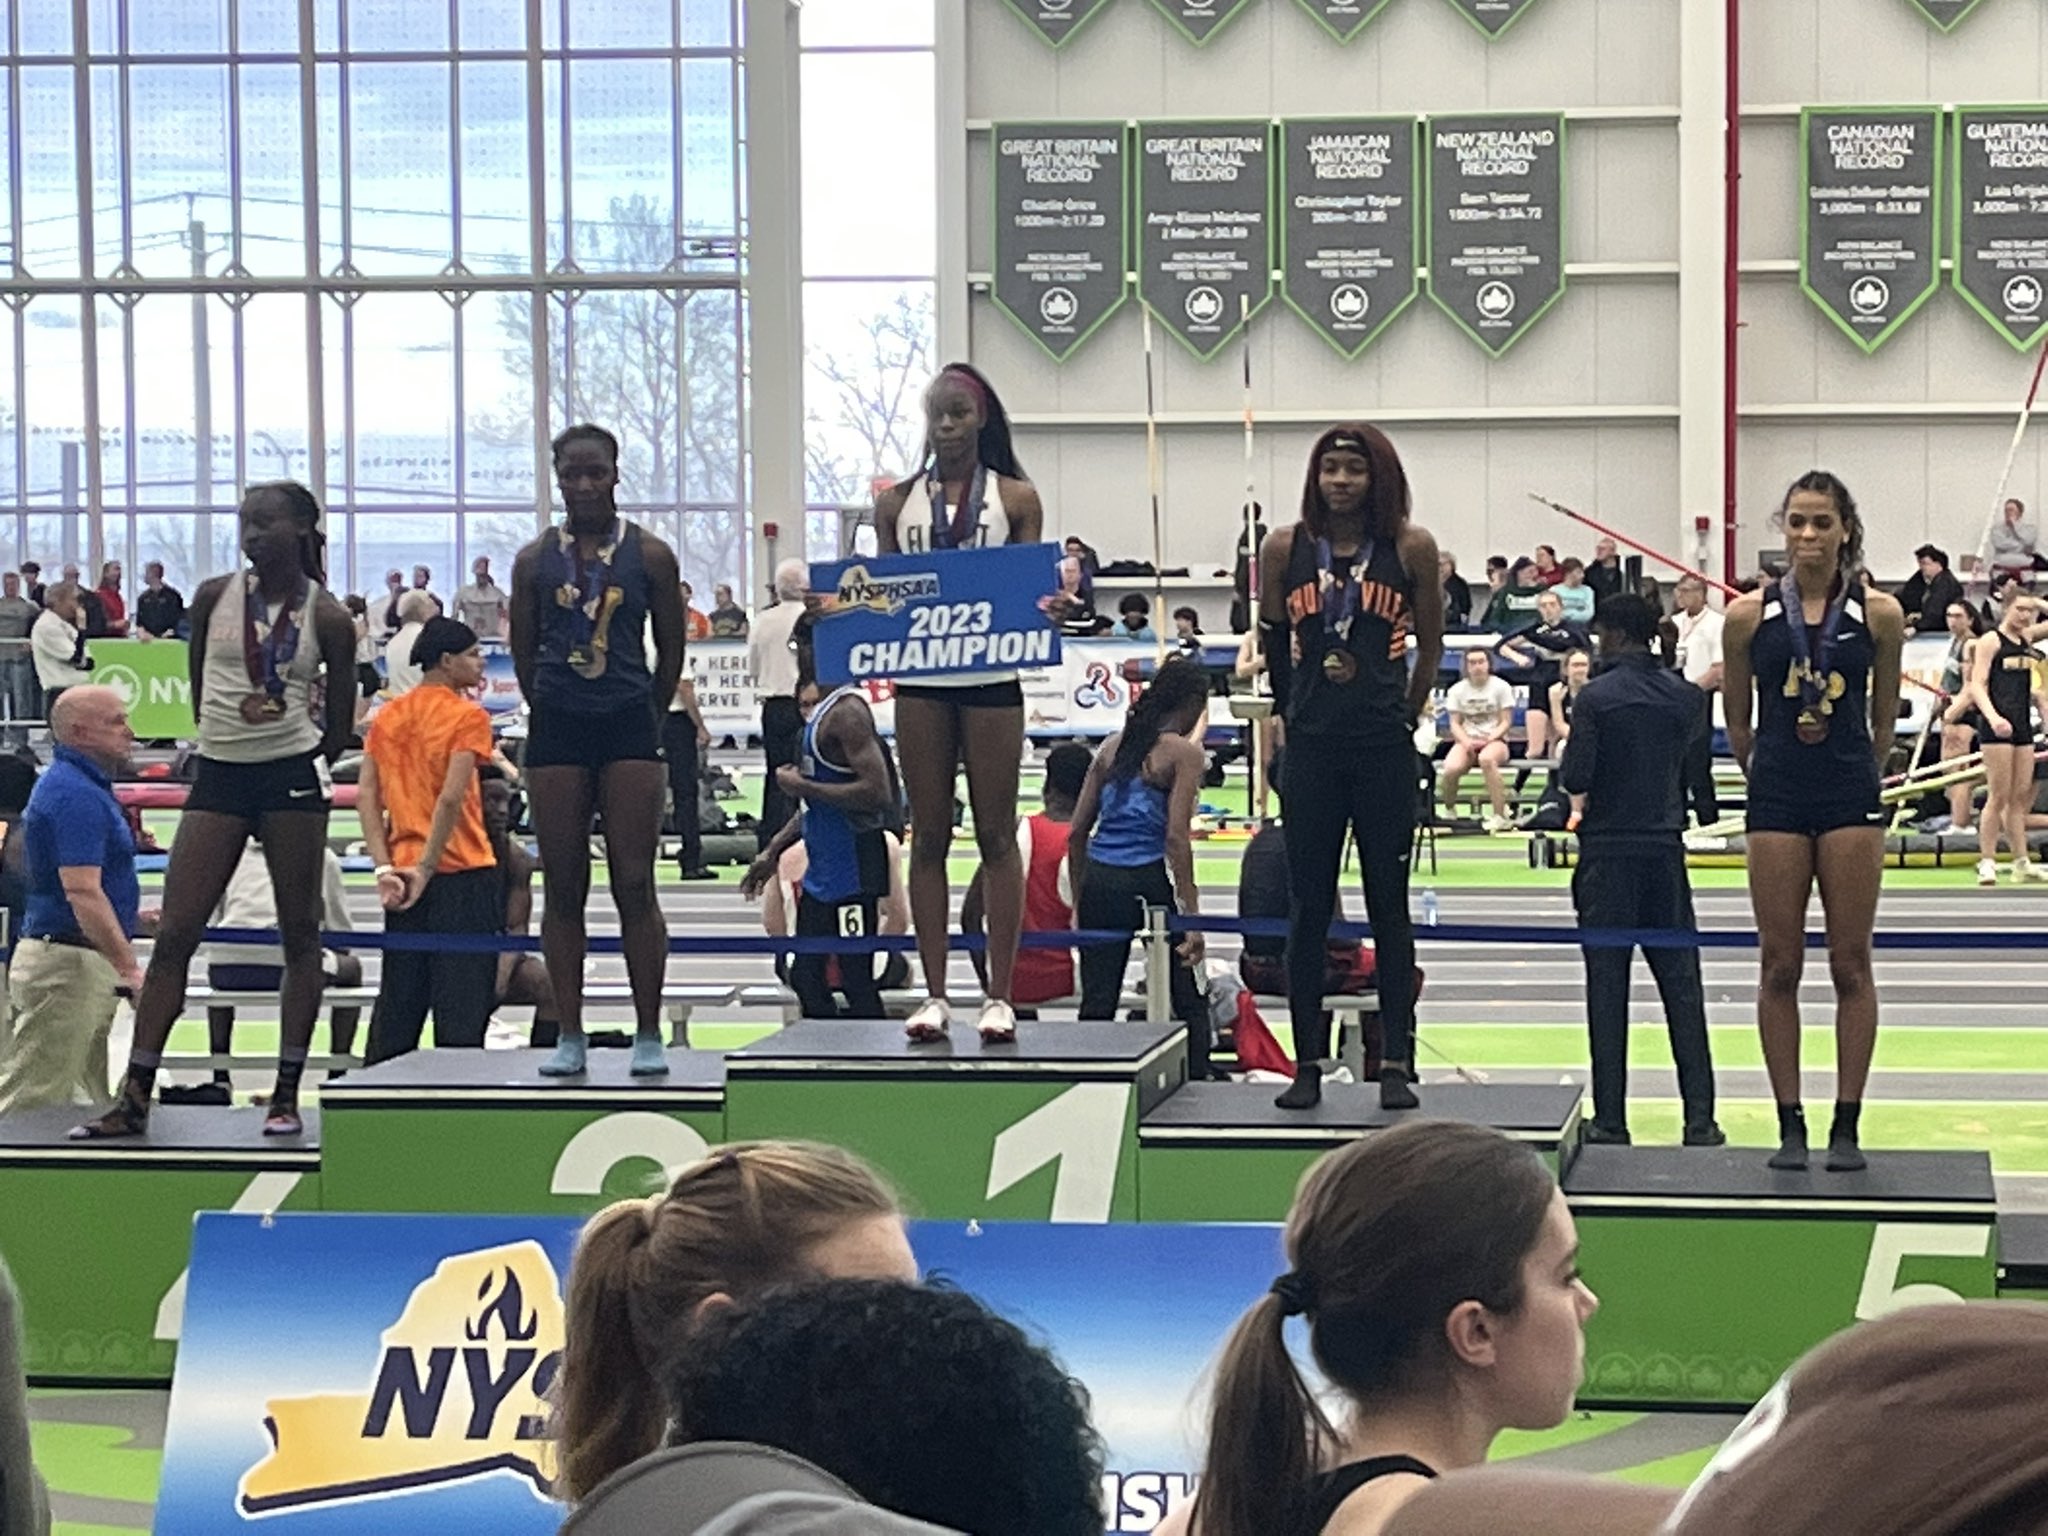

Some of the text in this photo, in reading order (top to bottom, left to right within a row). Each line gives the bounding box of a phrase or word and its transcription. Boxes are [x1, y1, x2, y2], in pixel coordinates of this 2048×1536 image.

[1436, 130, 1554, 148] NEW ZEALAND
[1827, 125, 1914, 140] CANADIAN
[1001, 139, 1117, 155] GREAT BRITAIN
[1146, 138, 1262, 154] GREAT BRITAIN
[1306, 135, 1390, 151] JAMAICAN
[1830, 138, 1914, 155] NATIONAL
[1166, 152, 1246, 168] NATIONAL
[1310, 149, 1391, 164] NATIONAL
[1456, 145, 1537, 161] NATIONAL
[1021, 154, 1101, 169] NATIONAL
[1461, 160, 1529, 176] RECORD
[1835, 154, 1904, 169] RECORD
[1027, 169, 1093, 183] RECORD
[1171, 167, 1238, 183] RECORD
[1315, 164, 1383, 179] RECORD
[908, 601, 993, 638] 2023
[849, 629, 1051, 677] CHAMPION
[697, 693, 740, 707] ERVE
[845, 907, 859, 935] 6
[985, 1082, 1131, 1224] 1
